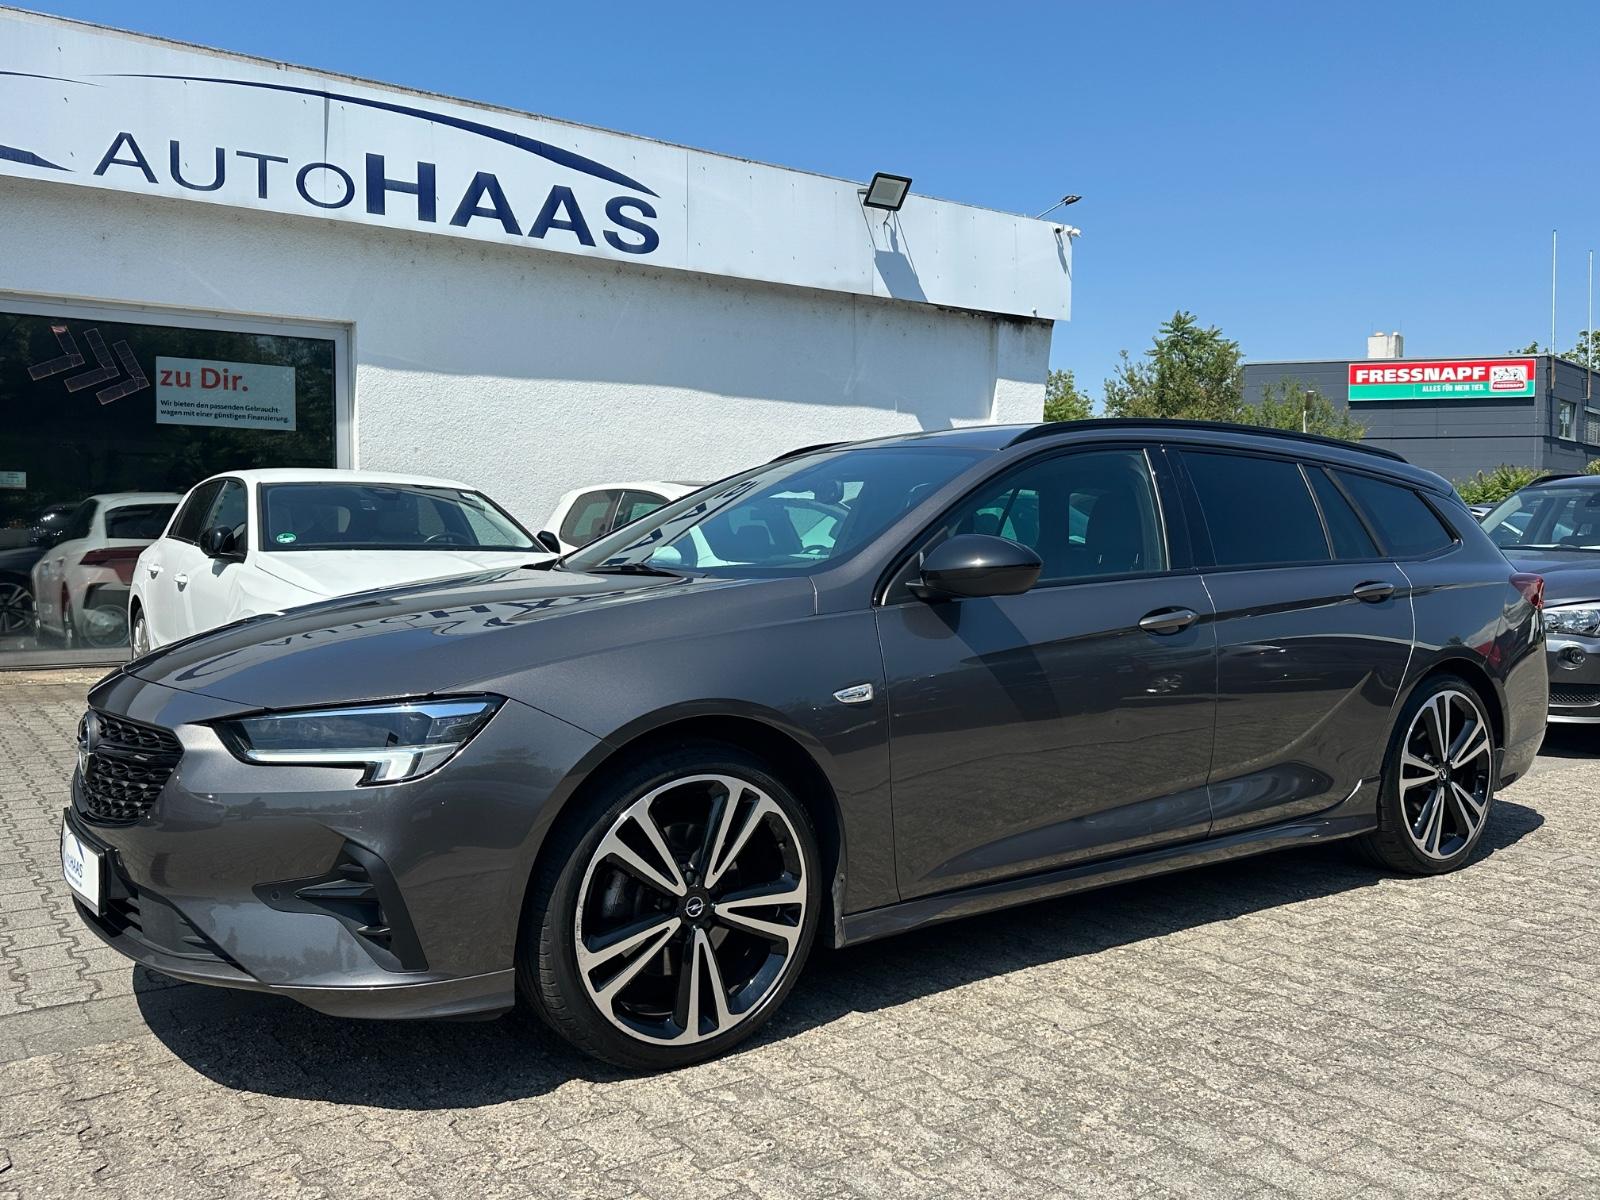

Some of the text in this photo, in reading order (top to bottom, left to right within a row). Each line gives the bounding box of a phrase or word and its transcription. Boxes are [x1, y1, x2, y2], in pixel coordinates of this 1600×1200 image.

[160, 367, 249, 392] zu Dir.
[1356, 366, 1486, 383] FRESSNAPF
[1422, 385, 1441, 393] ALLES
[174, 401, 195, 409] bieten
[196, 402, 209, 410] den
[210, 404, 244, 413] passenden
[160, 409, 182, 417] wagen
[214, 412, 247, 421] günstigen
